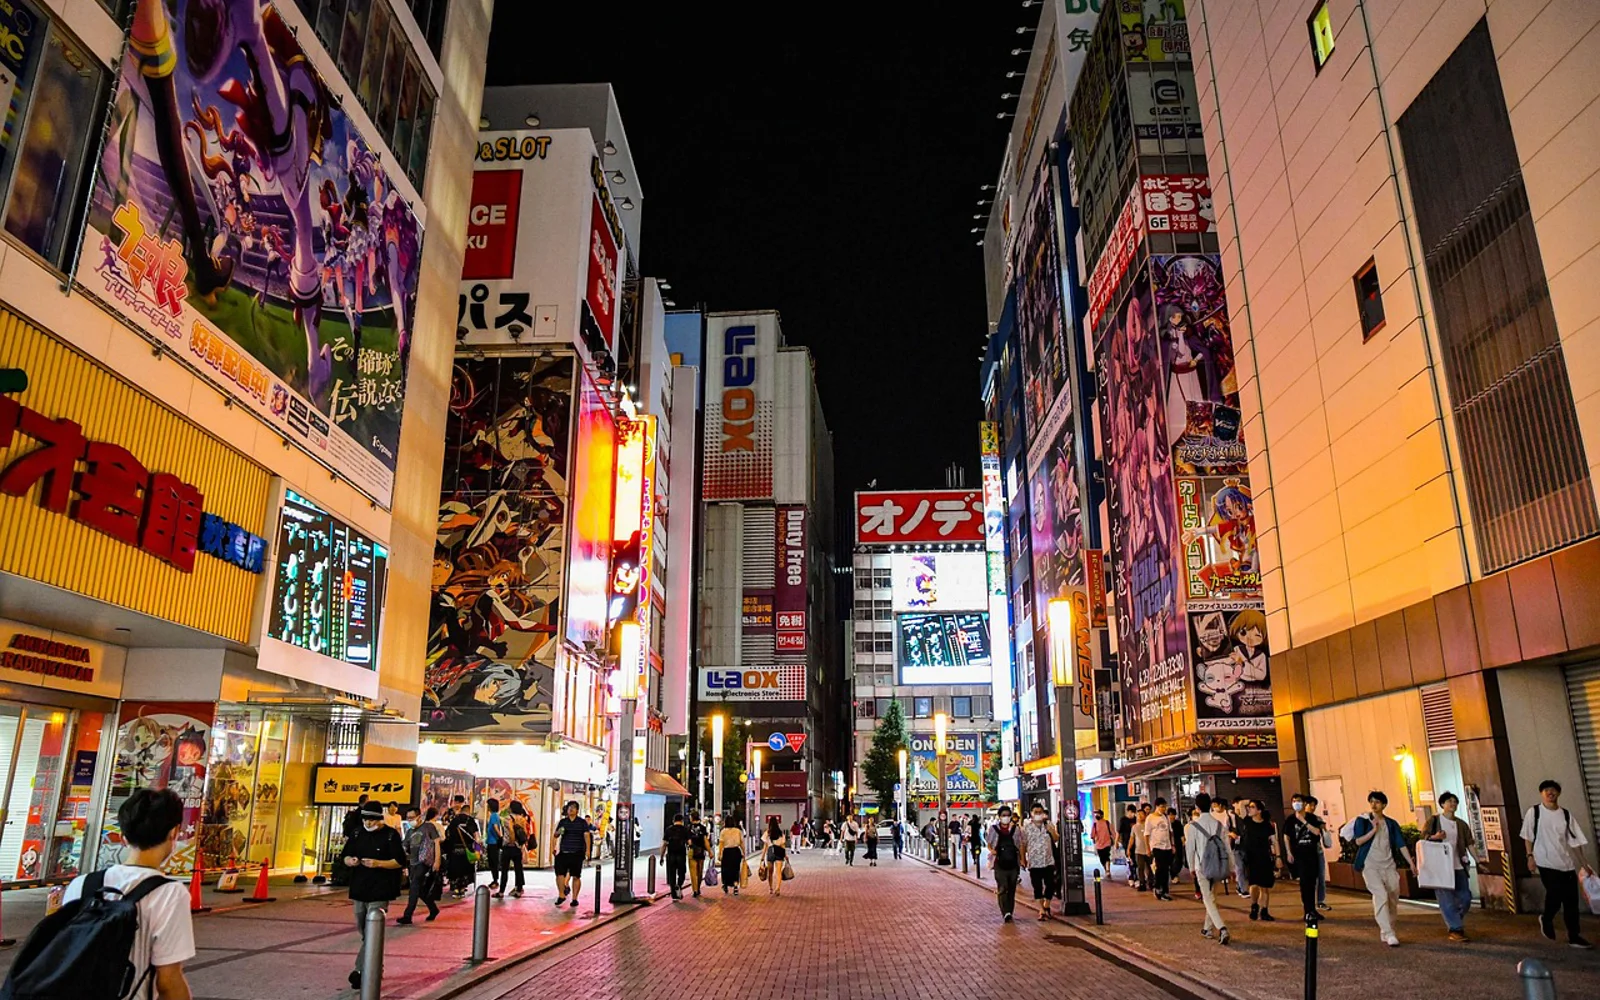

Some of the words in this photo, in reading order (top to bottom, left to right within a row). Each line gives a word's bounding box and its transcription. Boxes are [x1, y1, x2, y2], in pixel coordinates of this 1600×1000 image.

[474, 136, 552, 162] &SLOT
[1145, 190, 1197, 212] ぽち
[467, 204, 507, 226] CE
[1151, 216, 1169, 228] 6F
[0, 395, 203, 574] オ会館
[786, 511, 804, 546] Duty
[202, 512, 268, 573] 秋葉原
[787, 550, 804, 585] Free
[1198, 720, 1278, 729] ヴァイスシュヴァルツマ
[912, 739, 975, 751] ONDEN
[911, 780, 976, 791] AKIHBARA
